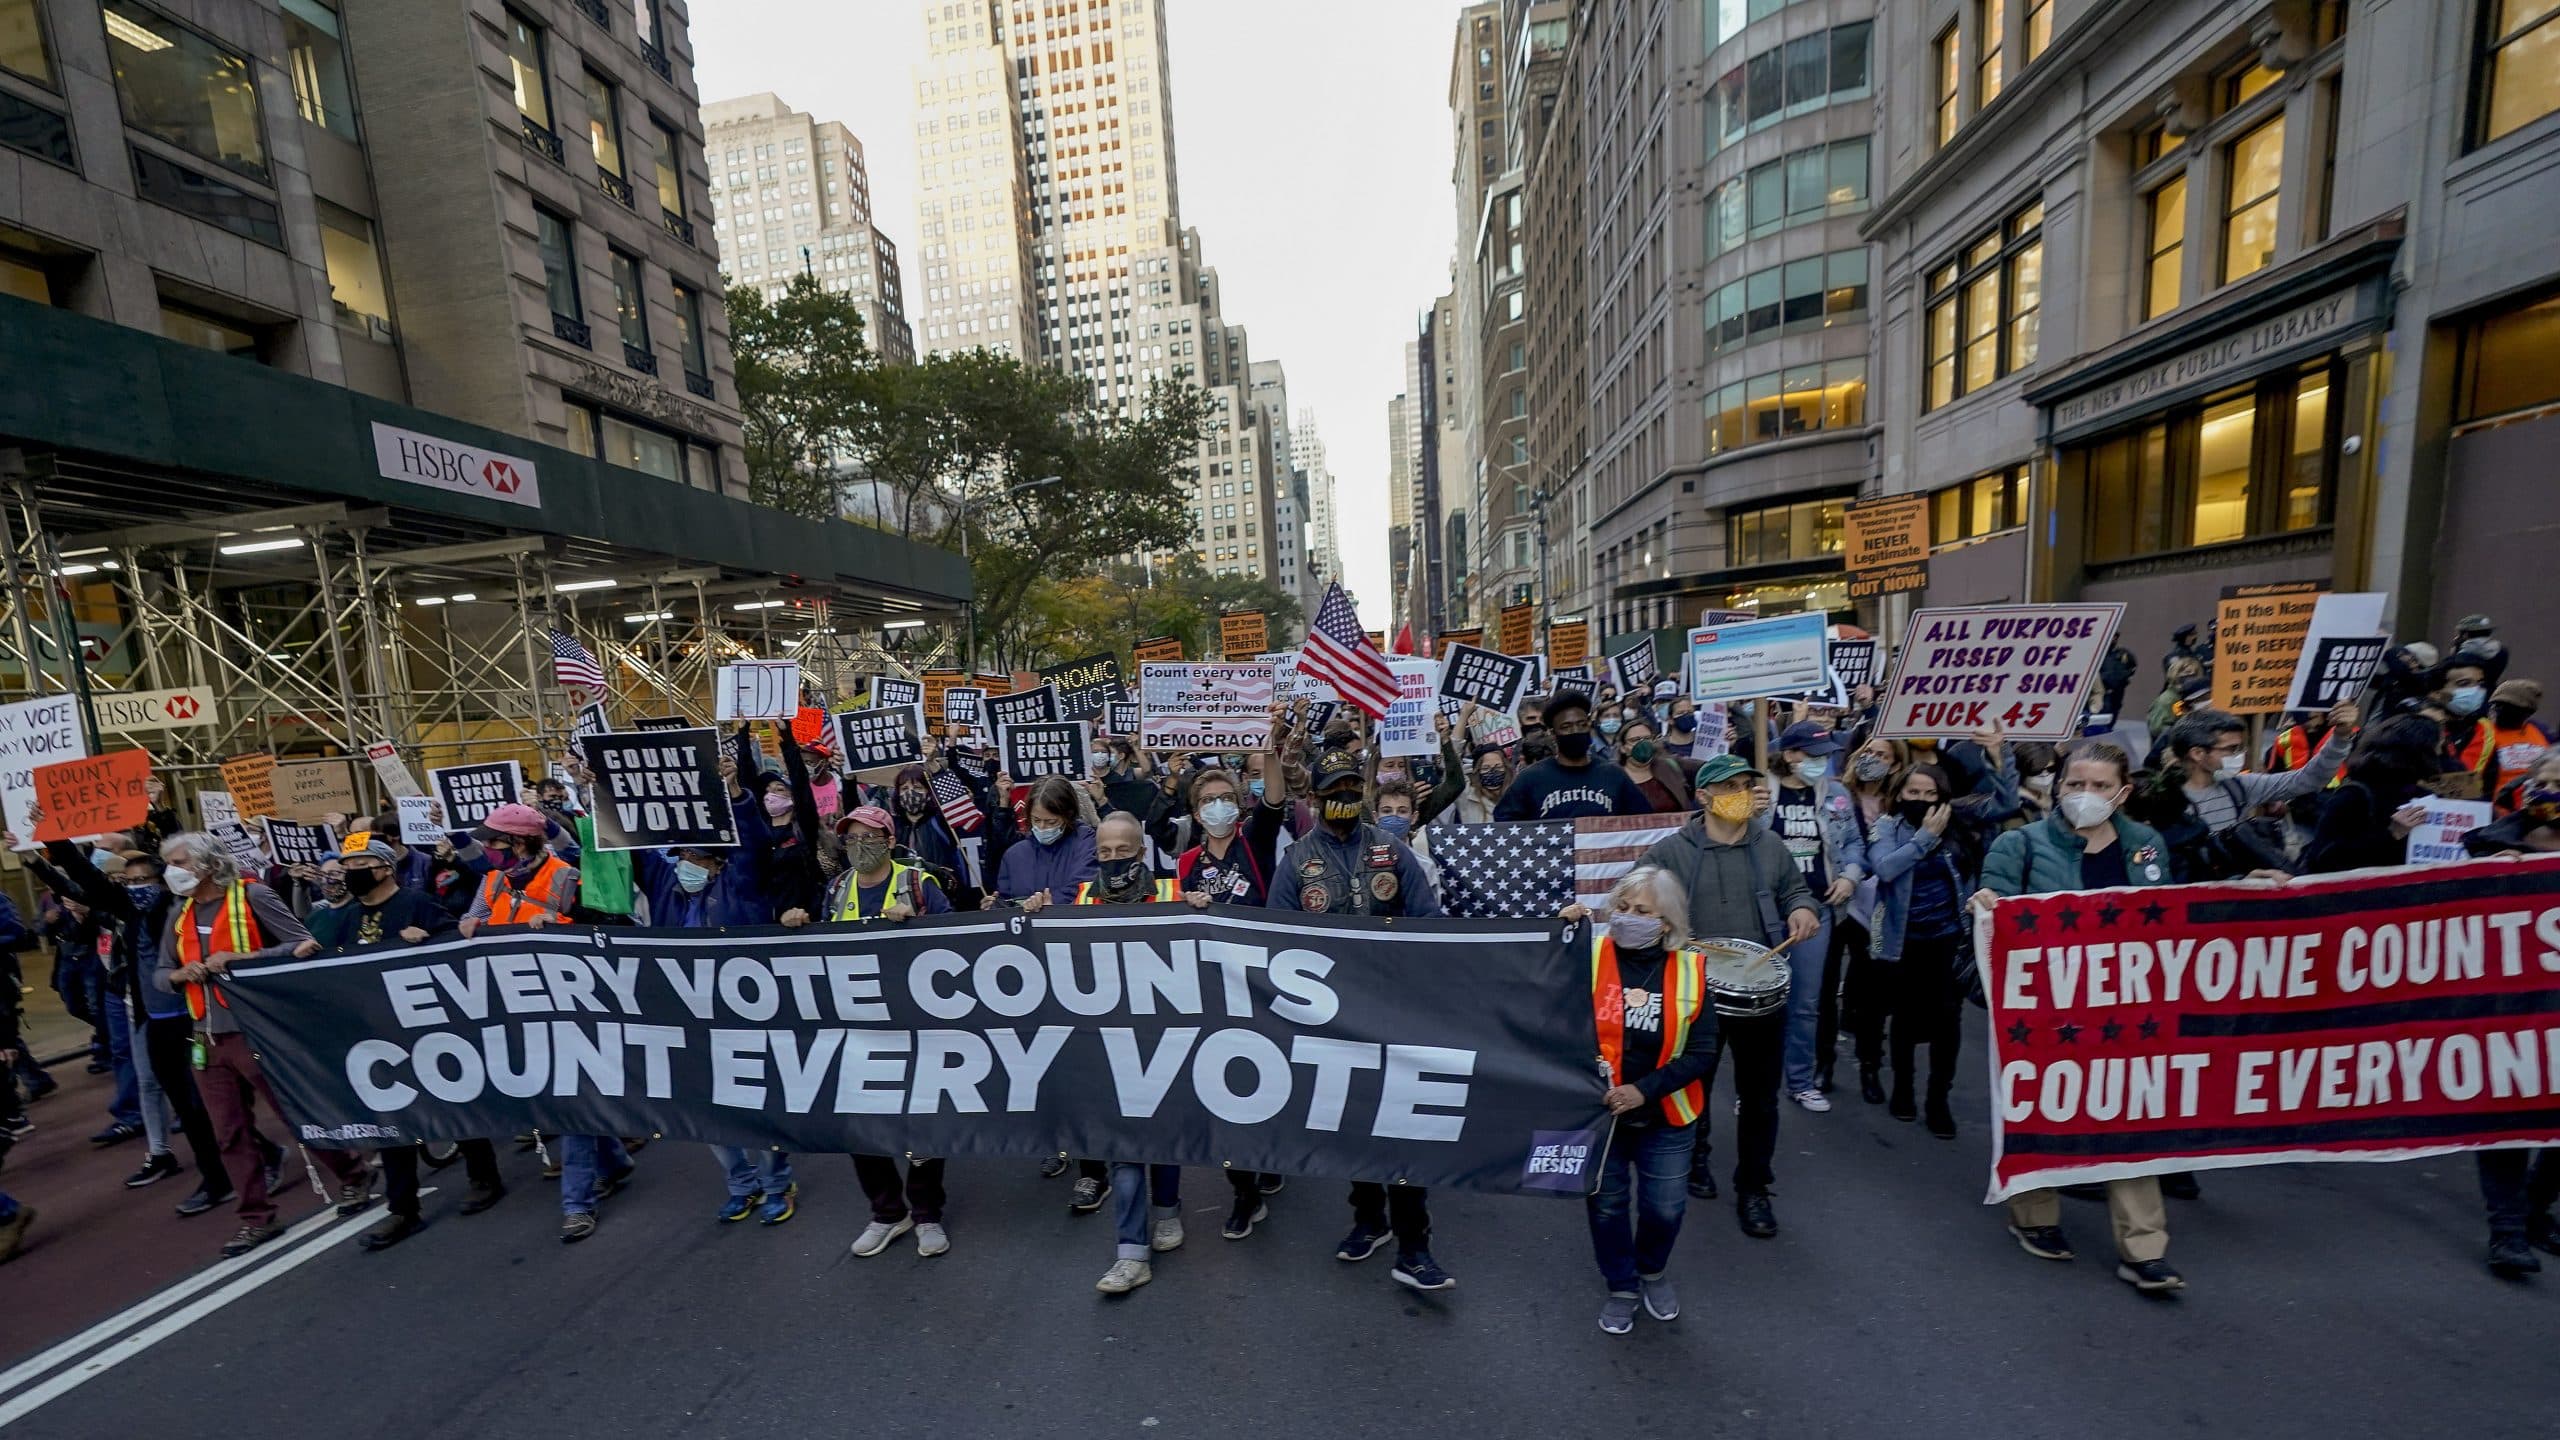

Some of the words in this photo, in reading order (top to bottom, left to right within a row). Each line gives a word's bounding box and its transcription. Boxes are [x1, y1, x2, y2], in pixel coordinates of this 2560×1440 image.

[2061, 401, 2087, 426] THE
[2091, 385, 2123, 414] NEW
[2127, 367, 2169, 400] YORK
[2176, 338, 2242, 382] PUBLIC
[2251, 298, 2342, 355] LIBRARY
[396, 437, 478, 487] HSBC
[1864, 534, 1910, 551] NEVER
[1854, 546, 1921, 565] Legitimate
[1850, 580, 1880, 597] OUT
[1883, 573, 1927, 592] NOW!
[2224, 606, 2240, 620] In
[2247, 604, 2274, 618] the
[2279, 602, 2315, 615] Nam
[1923, 620, 1971, 642] ALL
[1980, 617, 2099, 640] PURPOSE
[2221, 624, 2239, 638] of
[2244, 620, 2311, 637] Humani
[1225, 640, 1264, 651] STREETS!
[1834, 646, 1871, 657] COUNT
[2225, 642, 2250, 656] We
[2257, 639, 2304, 653] REFU
[2329, 645, 2382, 660] COUN
[1462, 653, 1515, 676] COUNT
[1832, 657, 1870, 669] EVERY
[1927, 646, 2015, 669] PISSED
[2022, 645, 2072, 668] OFF
[2231, 660, 2247, 673] to
[2253, 657, 2297, 671] Acce
[1144, 666, 1188, 678] Count
[1193, 668, 1234, 681] every
[1240, 667, 1272, 678] vote
[1457, 664, 1511, 689] EVERY
[2322, 661, 2376, 679] EVER
[883, 683, 915, 693] COUNT
[1273, 682, 1296, 690] VERY
[1453, 677, 1505, 705] VOTE
[1900, 673, 2009, 696] PROTEST
[2017, 673, 2081, 694] SIGN
[2232, 679, 2241, 690] a
[2248, 676, 2293, 688] Fasc
[2318, 680, 2366, 701] VO
[883, 690, 914, 703] EVERY
[948, 692, 976, 700] COUNT
[994, 694, 1045, 713] COUNT
[1177, 691, 1238, 701] Peaceful
[2229, 695, 2287, 708] Ameri
[25, 703, 71, 729] VOTE
[96, 698, 160, 727] HSBC
[997, 705, 1046, 723] EVERY
[1148, 702, 1202, 713] transfer
[1206, 702, 1220, 713] of
[1224, 704, 1268, 716] power
[1387, 701, 1426, 714] OUNT
[1905, 701, 1989, 728] FUCK
[2001, 702, 2050, 728] 45
[850, 714, 904, 732] COUNT
[1116, 722, 1138, 731] VOT
[22, 728, 73, 755] VOICE
[853, 727, 905, 747] EVERY
[1016, 731, 1070, 743] COUNT
[1146, 734, 1267, 747] DEMOCRACY
[603, 746, 697, 769] COUNT
[856, 743, 912, 763] VOTE
[1016, 744, 1071, 759] EVERY
[46, 759, 115, 789] COUNT
[295, 768, 323, 778] STOP
[1017, 759, 1076, 777] VOTE
[448, 771, 503, 788] COUNT
[609, 771, 701, 797] EVERY
[52, 778, 121, 811] EVERY
[452, 784, 505, 803] EVERY
[1540, 785, 1613, 818] Maricón
[56, 803, 121, 832] VOTE
[455, 802, 507, 822] VOT
[616, 801, 714, 832] VOTE
[271, 824, 317, 837] COUNT
[277, 836, 319, 848] EVERY
[278, 848, 323, 863] VOTE
[2002, 932, 2322, 1010] EVERYONE
[2337, 908, 2560, 993] COUNTS
[382, 952, 642, 1029] EVERY
[656, 954, 892, 1022] VOTE
[908, 939, 1340, 1025] COUNTS
[345, 1021, 686, 1113] COUNT
[709, 1026, 1074, 1114] EVERY
[1100, 1026, 1477, 1143] VOTE
[2001, 1052, 2210, 1122] COUNT
[1533, 1145, 1560, 1159] RISE
[1561, 1145, 1588, 1159] AND
[1529, 1157, 1586, 1175] RESIST
